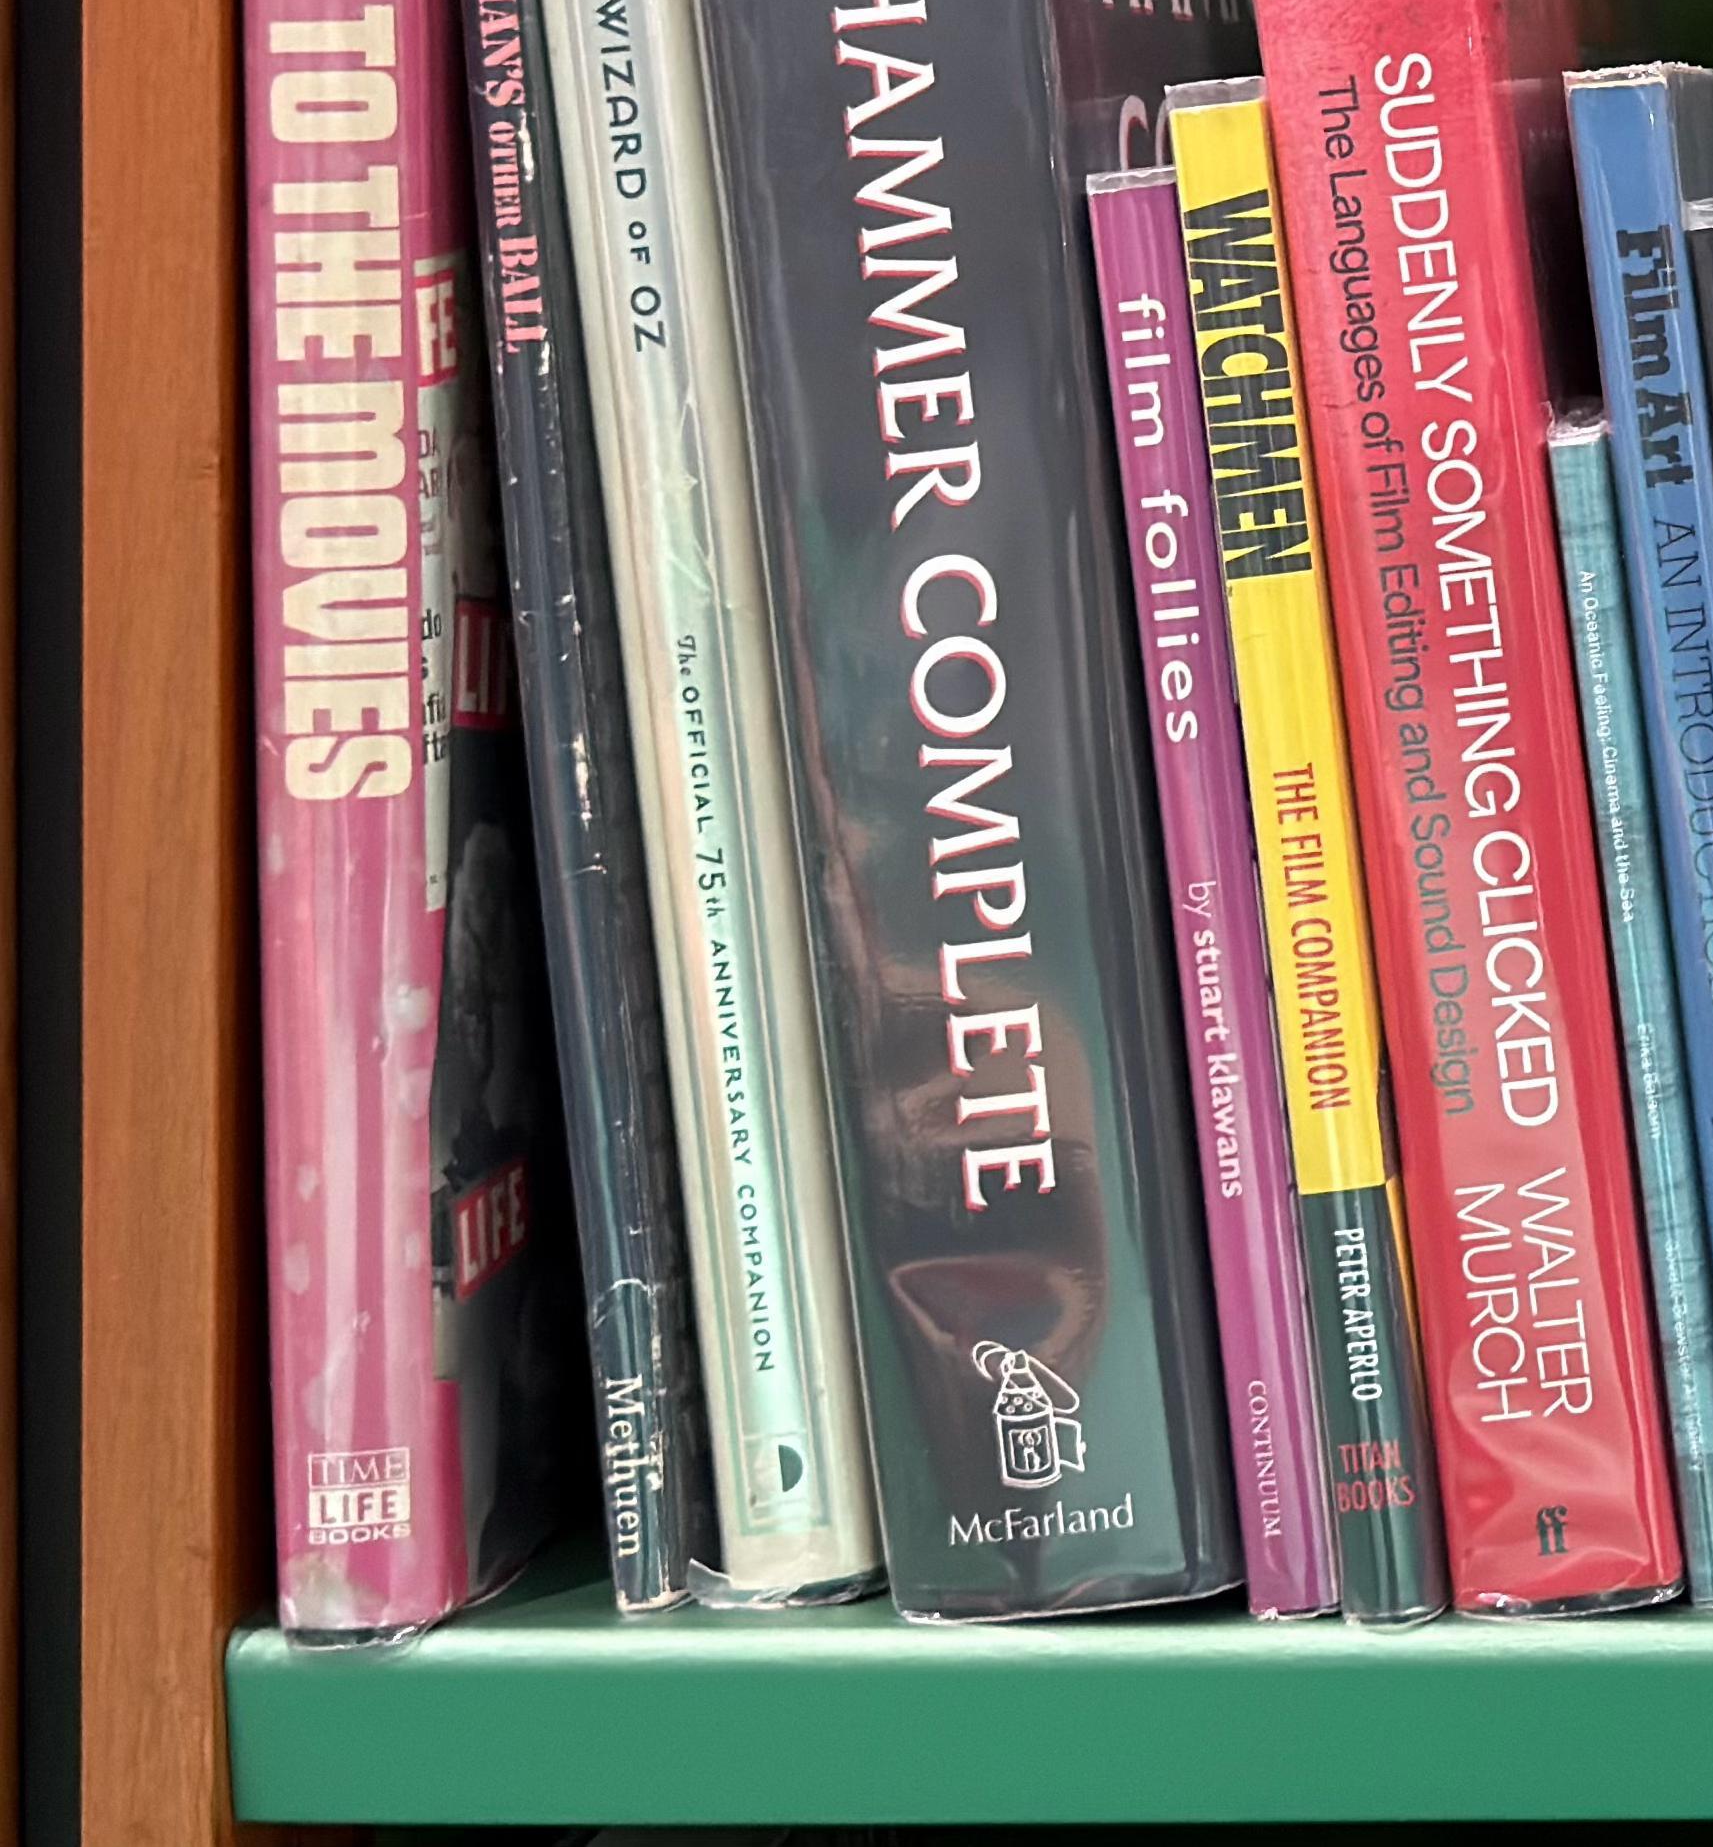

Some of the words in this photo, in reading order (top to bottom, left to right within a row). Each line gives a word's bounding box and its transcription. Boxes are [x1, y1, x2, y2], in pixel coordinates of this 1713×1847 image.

[269, 4, 397, 143] TO
[1319, 75, 1359, 160] The
[488, 121, 521, 227] OTHER
[1375, 53, 1473, 402] SUDDENLY
[273, 165, 402, 361] THE
[499, 235, 547, 353] BALL
[629, 285, 666, 353] OZ
[1325, 168, 1386, 403] Languages
[1617, 225, 1679, 380] Film
[1119, 292, 1171, 448] film
[1184, 188, 1313, 581] WATCHMEN
[1637, 391, 1694, 488] Art
[277, 379, 412, 801] MOVIES
[1139, 489, 1200, 743] follies
[1421, 420, 1521, 819] SOMETHING
[1579, 570, 1596, 593] An
[1654, 517, 1699, 591] AN
[677, 634, 695, 677] The
[1380, 563, 1429, 712] Editing
[1584, 597, 1603, 669] Oceanic
[679, 686, 713, 834] OFFICIAL
[1272, 762, 1316, 823] THE
[1603, 746, 1620, 813] Cinema
[1611, 816, 1628, 850] and
[900, 553, 1057, 1213] COMPLETE
[1281, 836, 1324, 907] FILM
[1411, 813, 1464, 953] Sound
[1616, 854, 1630, 885] the
[1620, 888, 1635, 923] Sea
[708, 938, 754, 1165] ANNIVERSARY
[1288, 916, 1351, 1111] COMPANION
[1428, 966, 1475, 1116] Design
[1473, 831, 1558, 1126] CLICKED
[1206, 1052, 1244, 1198] klawans
[736, 1184, 775, 1373] COMPANION
[1455, 1183, 1531, 1423] MURCH
[1518, 1166, 1593, 1417] WALTER
[604, 1375, 647, 1558] Methuen
[948, 1493, 1134, 1546] McFarland
[1246, 1380, 1282, 1538] CONTINUUM
[308, 1523, 411, 1545] BOOKS
